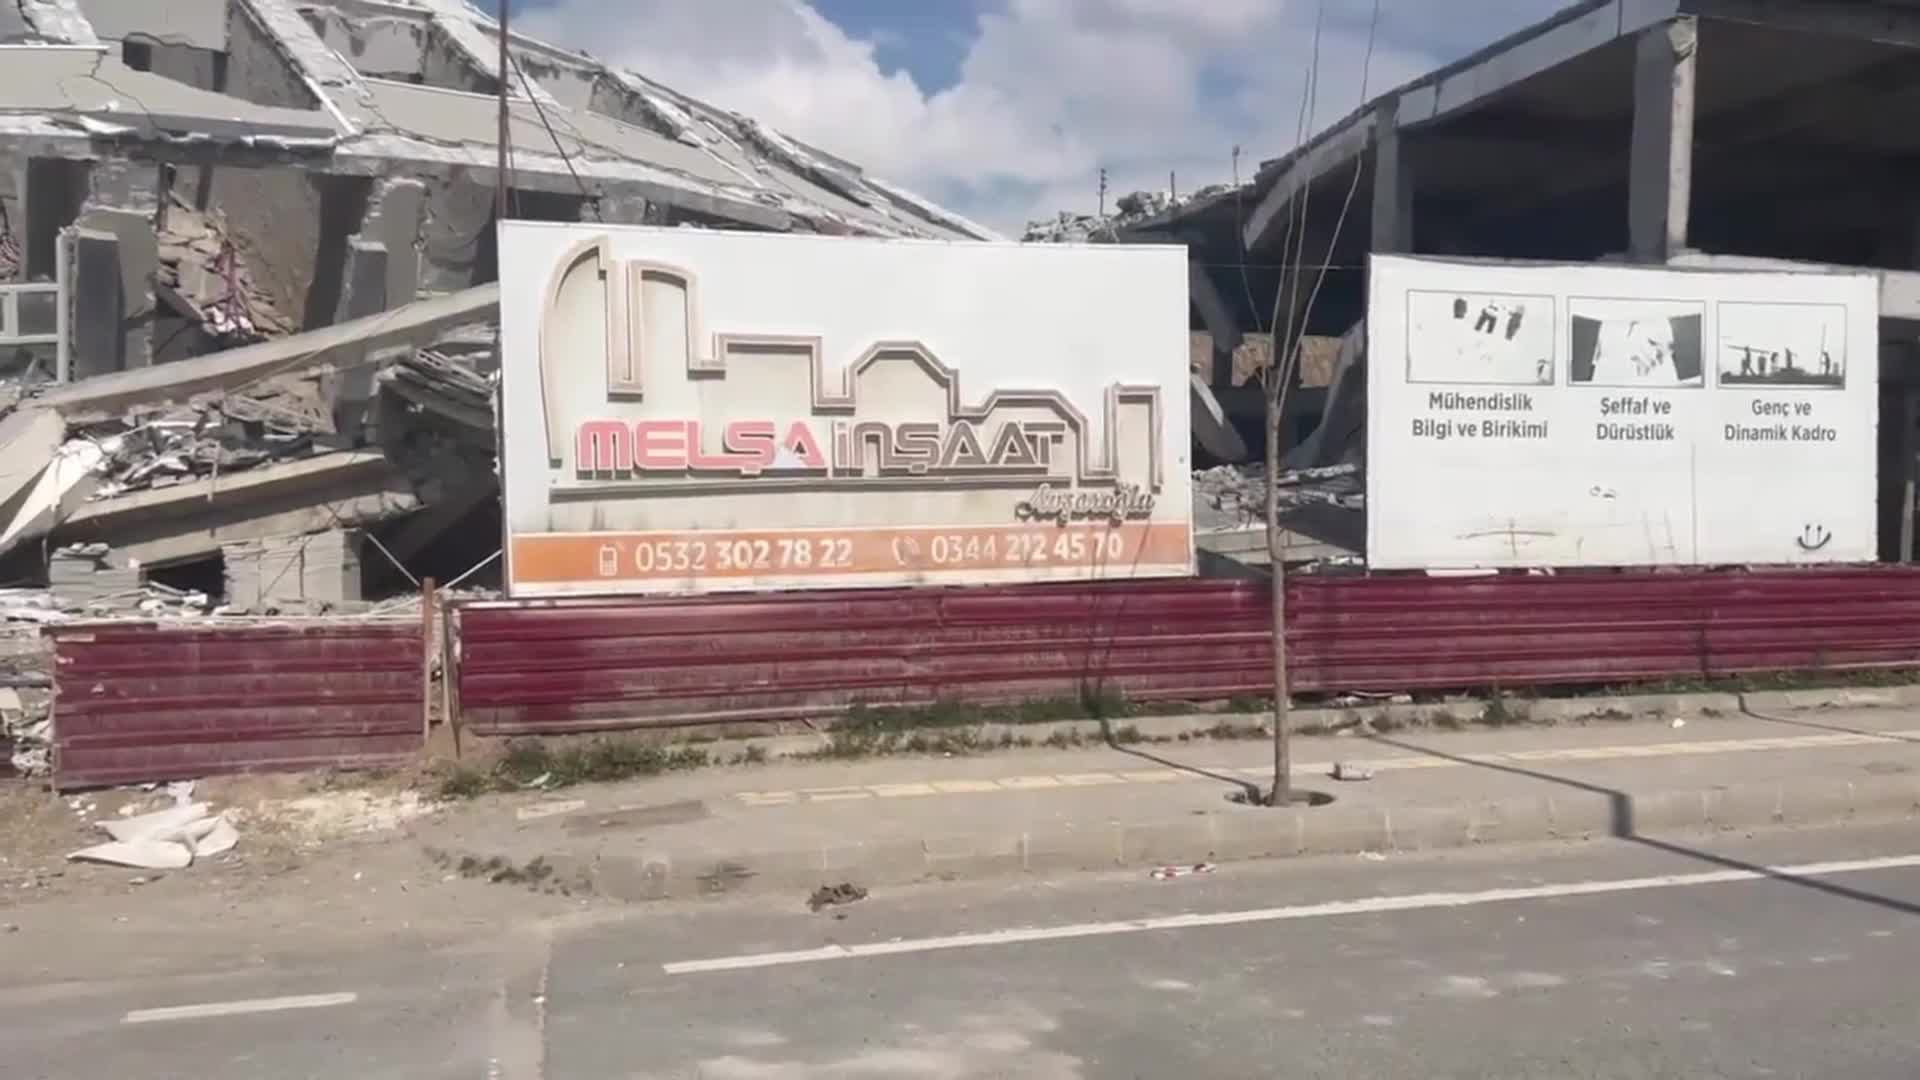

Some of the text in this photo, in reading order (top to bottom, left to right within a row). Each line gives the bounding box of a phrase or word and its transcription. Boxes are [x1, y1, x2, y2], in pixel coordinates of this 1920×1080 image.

[1428, 392, 1533, 411] Mühendislik
[1600, 397, 1671, 417] Şeffaf ve
[1751, 399, 1812, 417] Genç ve
[1412, 418, 1548, 440] Bilgi ve Birikimi
[1596, 422, 1675, 441] Dürüstlük
[1724, 423, 1837, 441] Dinamik Kadro
[576, 420, 827, 477] MELŞA
[634, 538, 853, 573] 0532 302 78 22
[931, 532, 1124, 563] 0344 212 45 70
